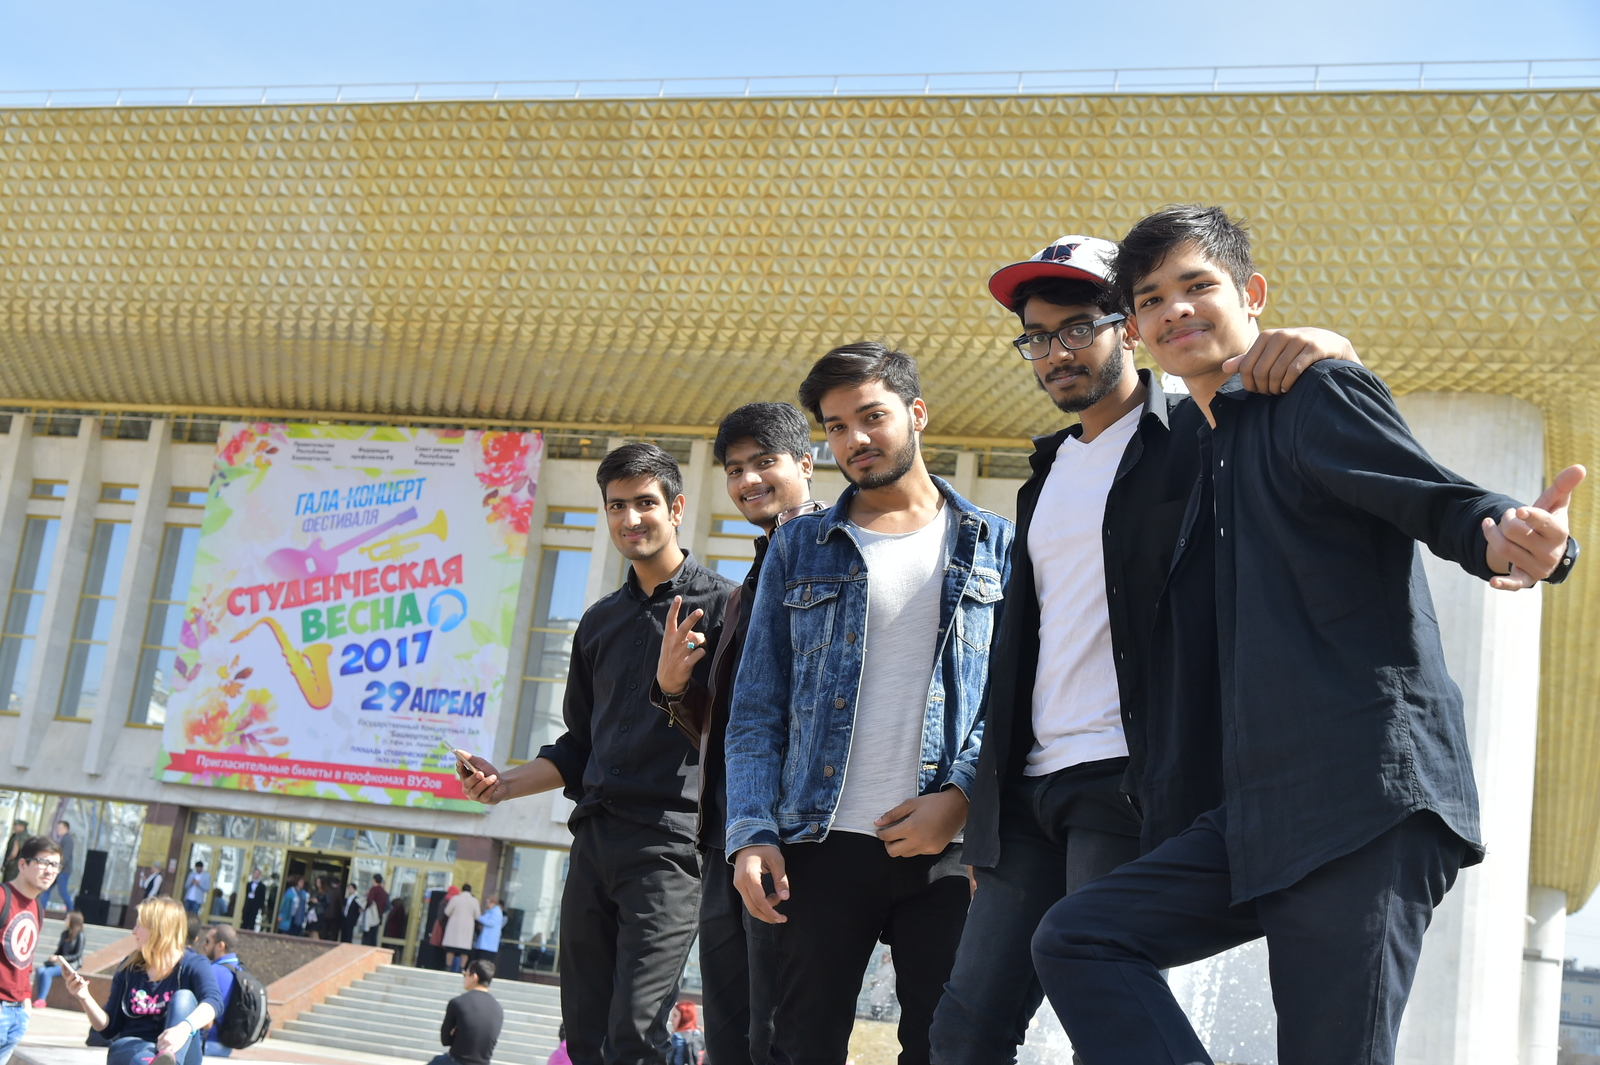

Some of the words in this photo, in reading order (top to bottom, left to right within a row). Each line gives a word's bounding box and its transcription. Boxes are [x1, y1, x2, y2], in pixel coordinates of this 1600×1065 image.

[295, 477, 426, 515] ГАЛА-КОНЦЕРТ
[302, 509, 379, 533] ФЕСТИВАЛЯ
[227, 554, 463, 616] СТУДЕНЧЕСКАЯ
[300, 592, 423, 643] ВЕСНА
[340, 630, 432, 676] 2017
[360, 681, 411, 711] 29
[409, 688, 486, 718] АПРЕЛЯ
[196, 754, 290, 775] Пригласительные
[292, 763, 333, 779] билеты
[335, 771, 341, 779] в
[343, 769, 405, 787] профкомах
[407, 775, 443, 789] ВУЗов
